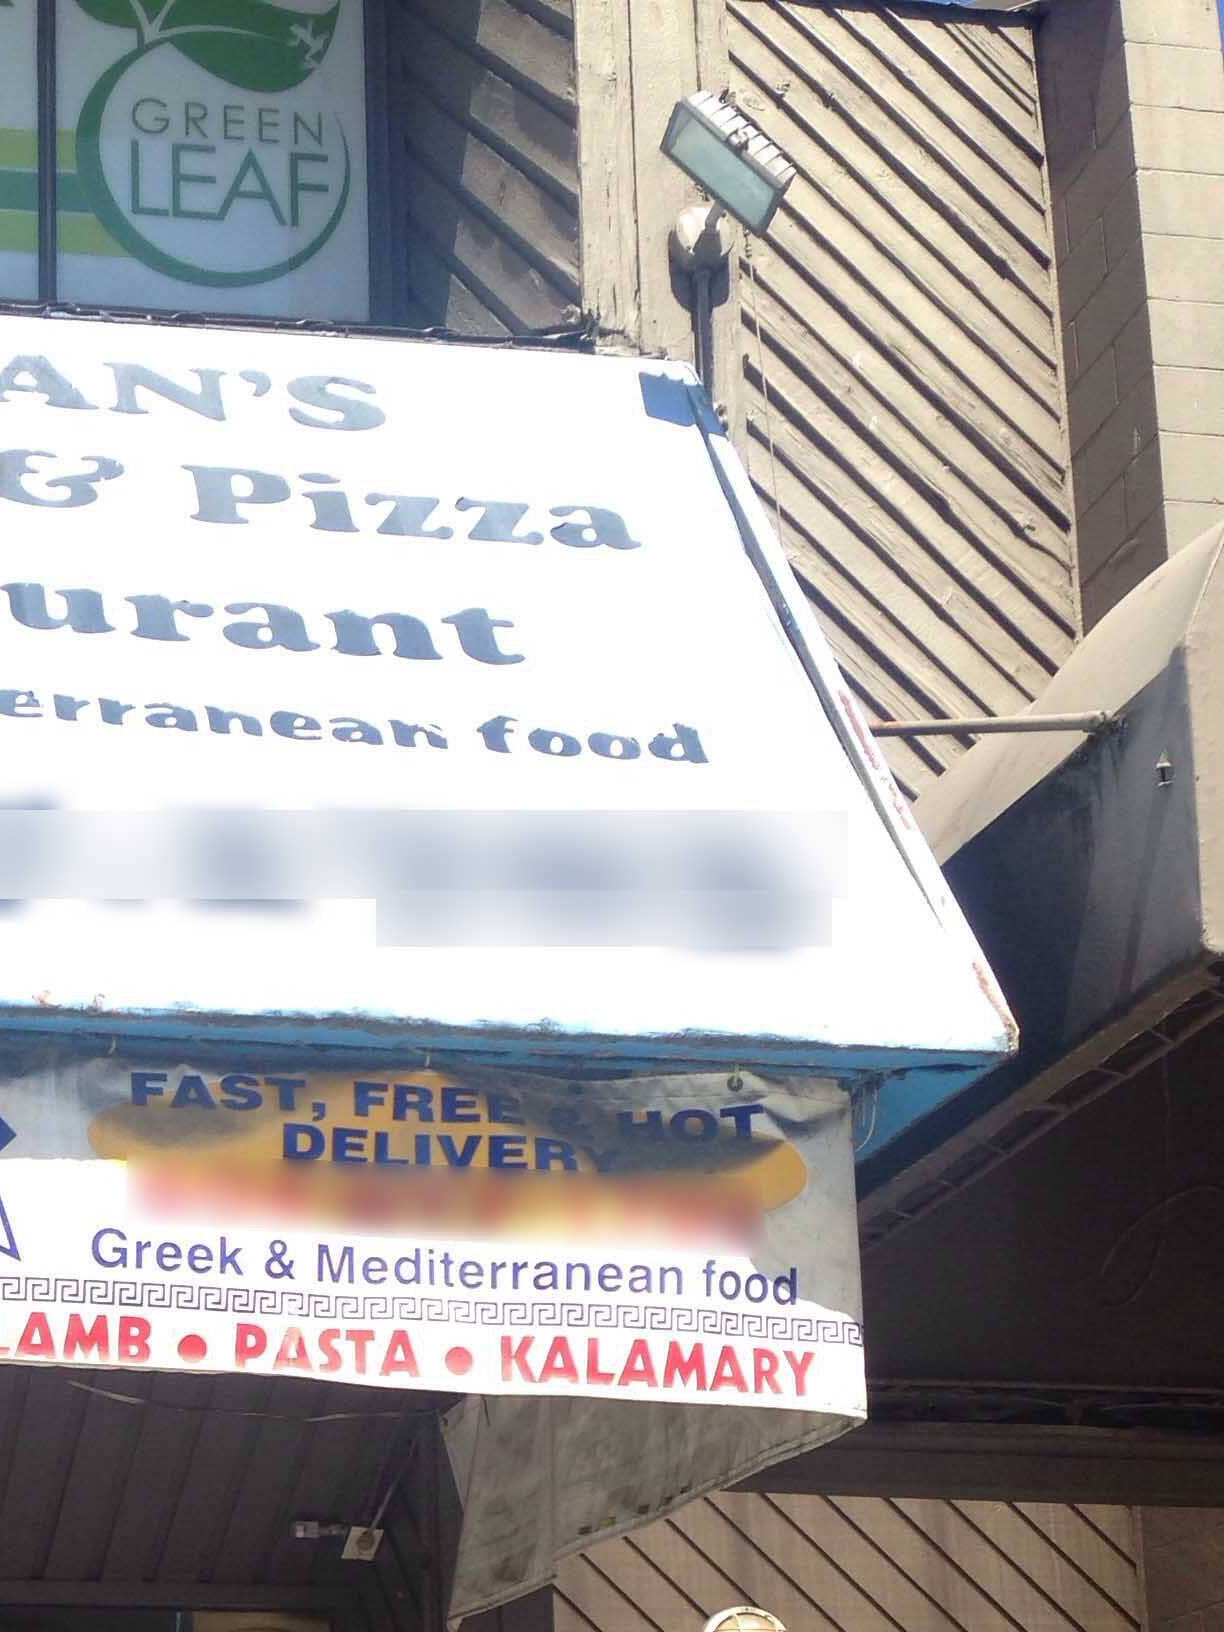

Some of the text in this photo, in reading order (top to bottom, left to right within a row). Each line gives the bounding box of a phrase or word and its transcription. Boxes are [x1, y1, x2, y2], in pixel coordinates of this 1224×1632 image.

[131, 97, 324, 146] GREEN
[131, 138, 329, 227] LEAF
[180, 464, 643, 552] Pizza
[477, 715, 710, 764] food
[130, 1071, 328, 1123] FAST,
[620, 1103, 764, 1144] HOT
[283, 1123, 618, 1173] DELIVERY
[91, 1226, 799, 1309] Greek & Mediterranean food
[233, 1321, 420, 1380] PASTA
[499, 1335, 817, 1398] KALAMARY
